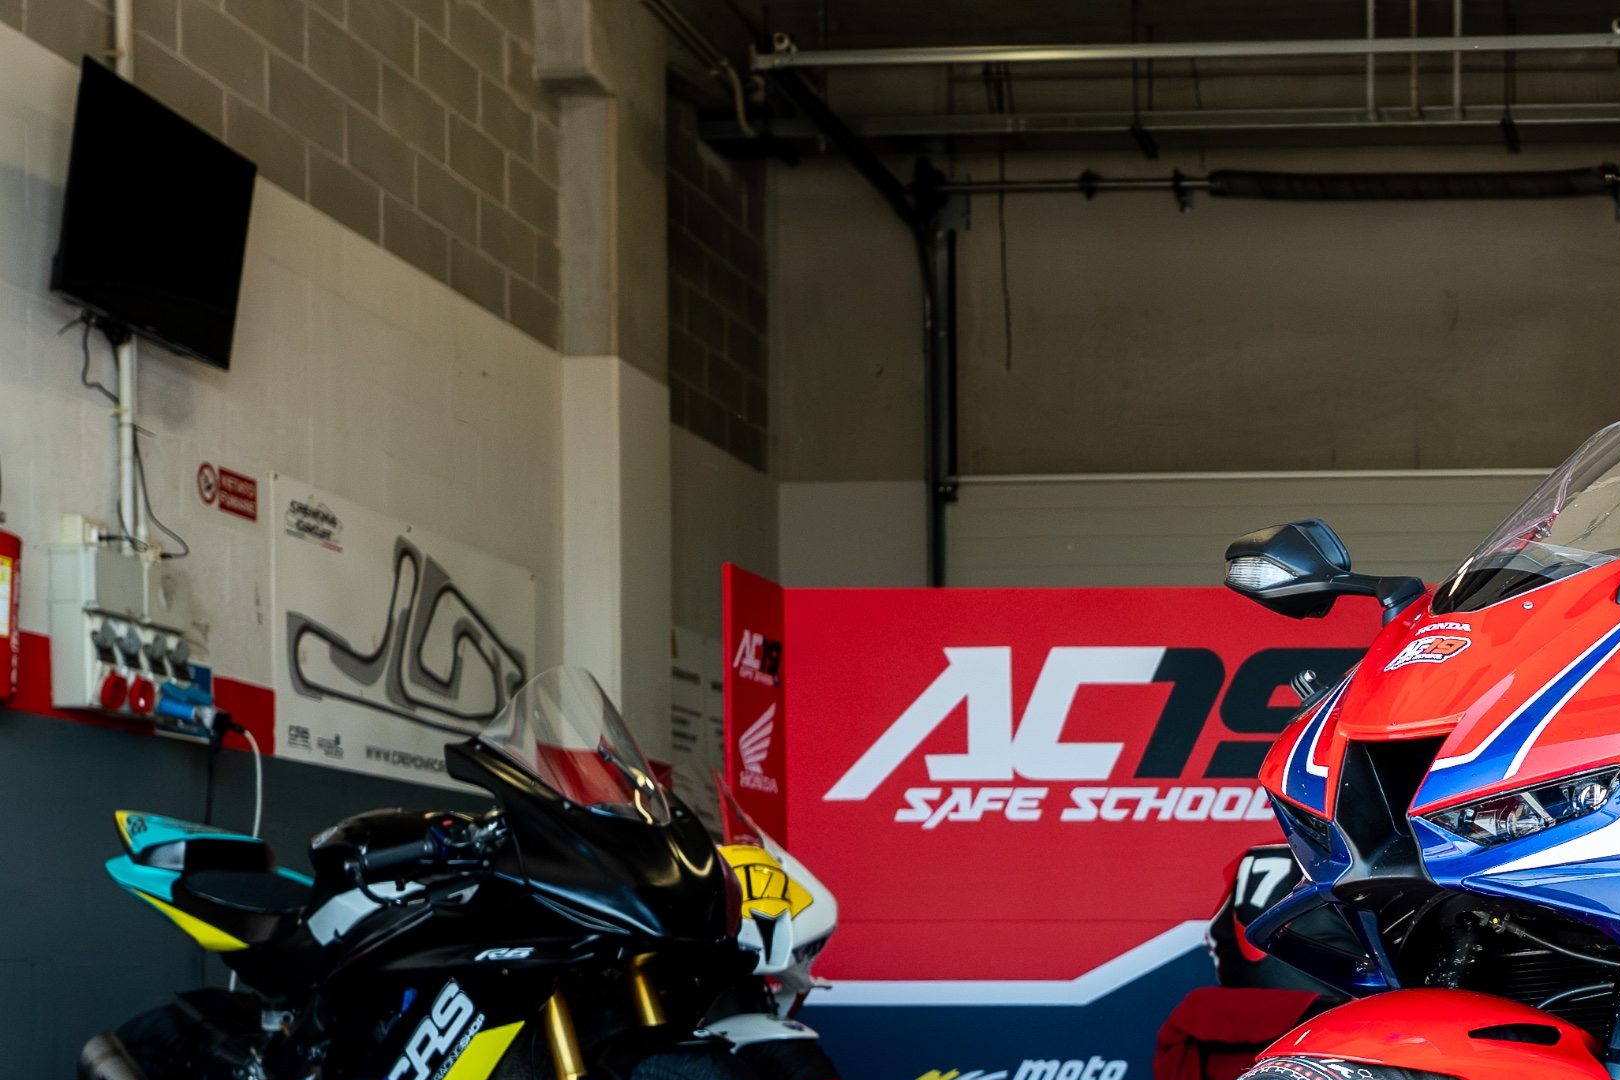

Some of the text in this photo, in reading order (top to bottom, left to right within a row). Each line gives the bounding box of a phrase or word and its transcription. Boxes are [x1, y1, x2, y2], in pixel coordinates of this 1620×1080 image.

[1415, 622, 1471, 636] HONDA
[895, 787, 1047, 829] SAFE
[1234, 856, 1292, 908] 17
